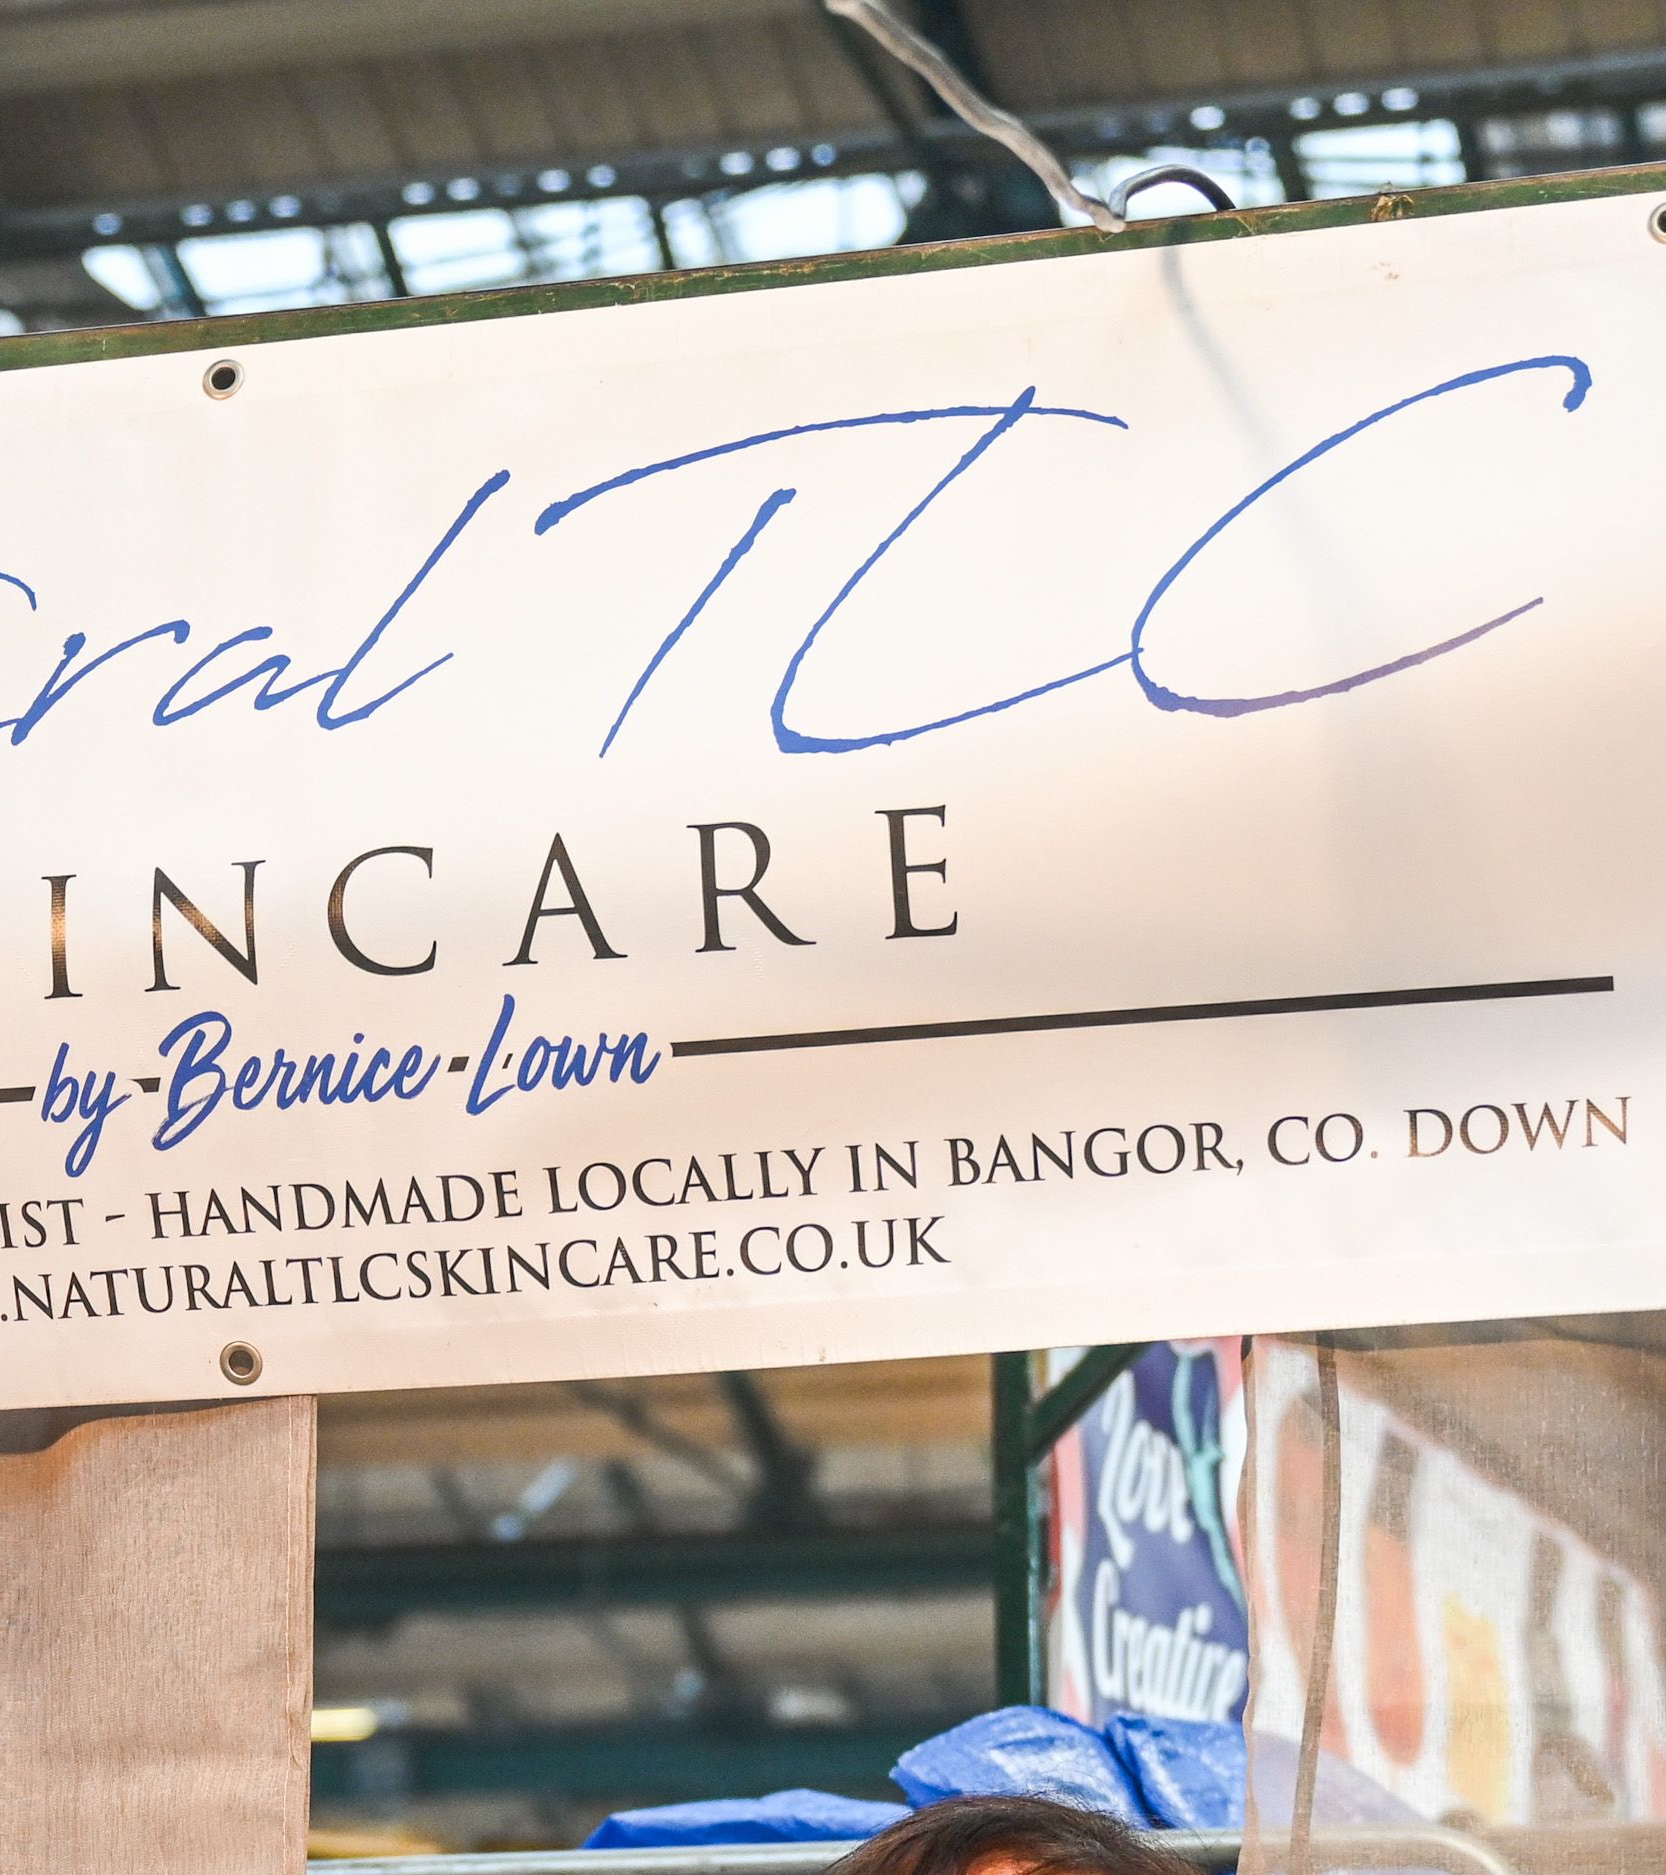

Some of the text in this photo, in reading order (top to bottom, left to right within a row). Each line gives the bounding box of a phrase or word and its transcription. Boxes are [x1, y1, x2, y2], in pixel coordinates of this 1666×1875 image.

[534, 355, 1592, 757] TLC
[41, 993, 663, 1178] by Bernice Lown
[147, 1170, 524, 1243] HANDMADE
[546, 1146, 823, 1217] LOCALLY
[846, 1141, 920, 1196] IN
[947, 1114, 1245, 1187] BANGOR,
[1267, 1113, 1379, 1167] CO.
[1408, 1095, 1632, 1161] DOWN
